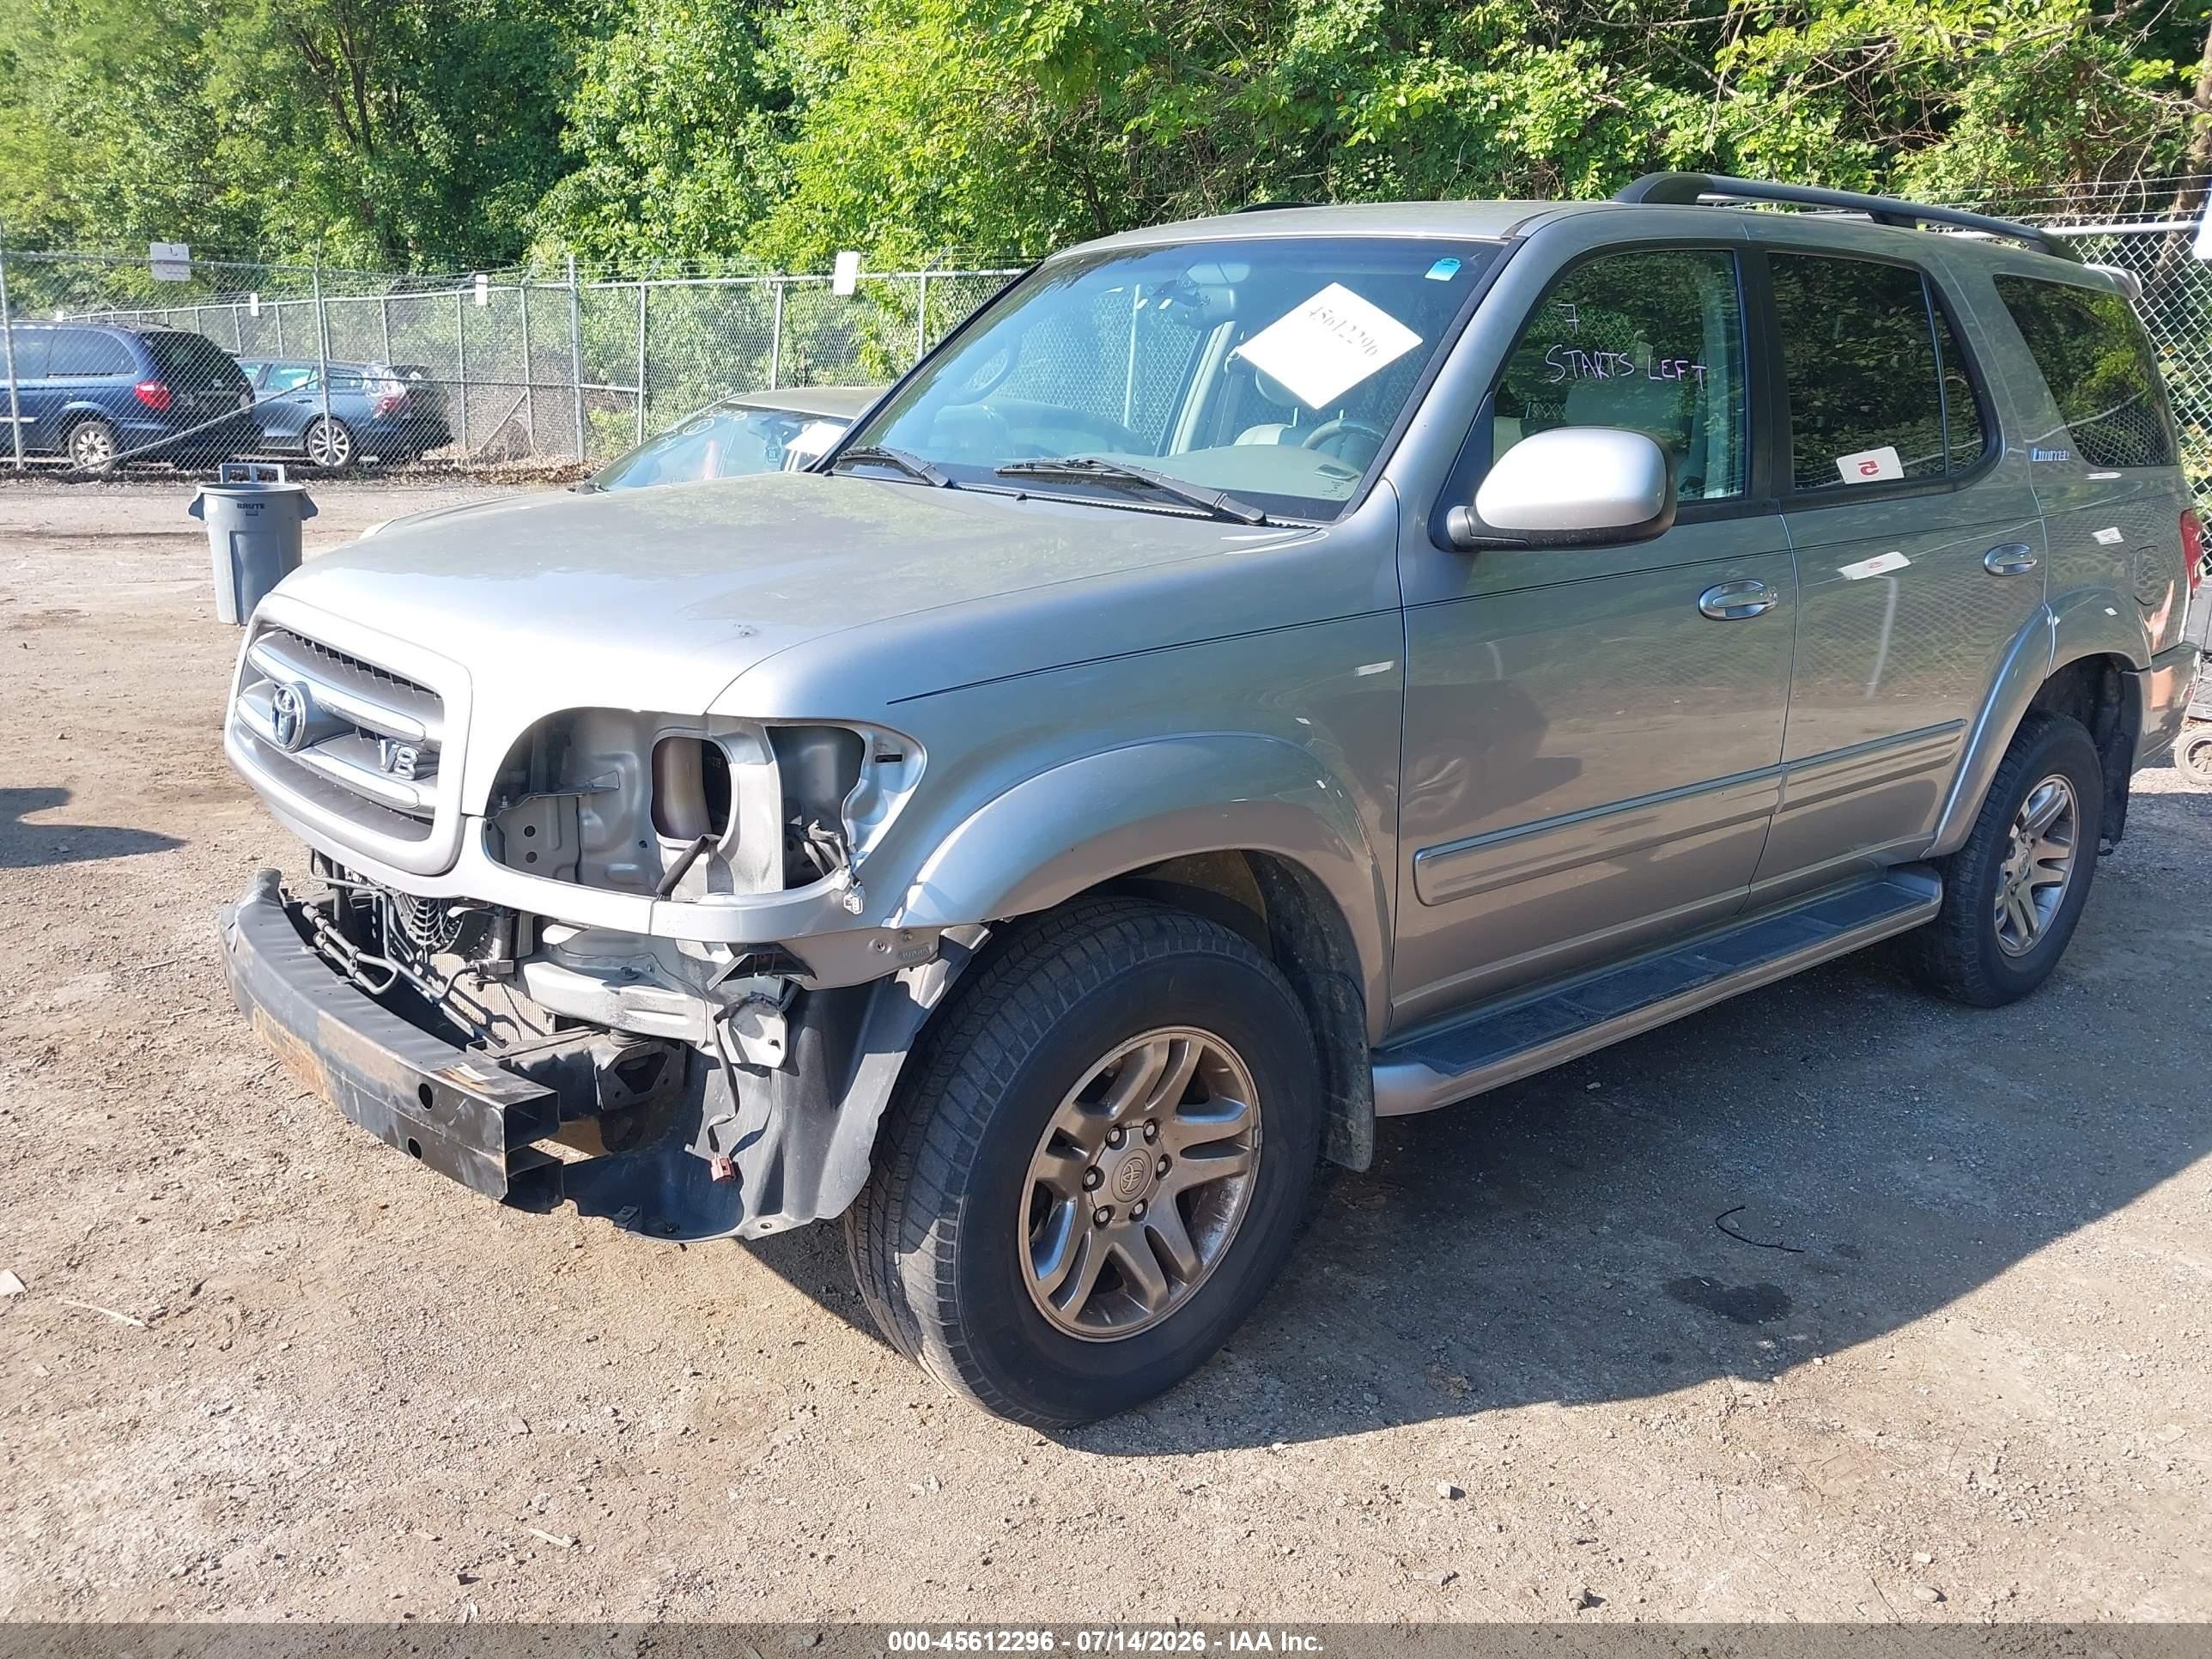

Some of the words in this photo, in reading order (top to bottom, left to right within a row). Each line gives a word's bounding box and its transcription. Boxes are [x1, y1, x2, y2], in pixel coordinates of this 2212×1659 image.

[1557, 303, 1580, 335] 7
[1545, 343, 1635, 383] STARTS
[1648, 353, 1707, 392] LEFT
[379, 738, 420, 781] V8
